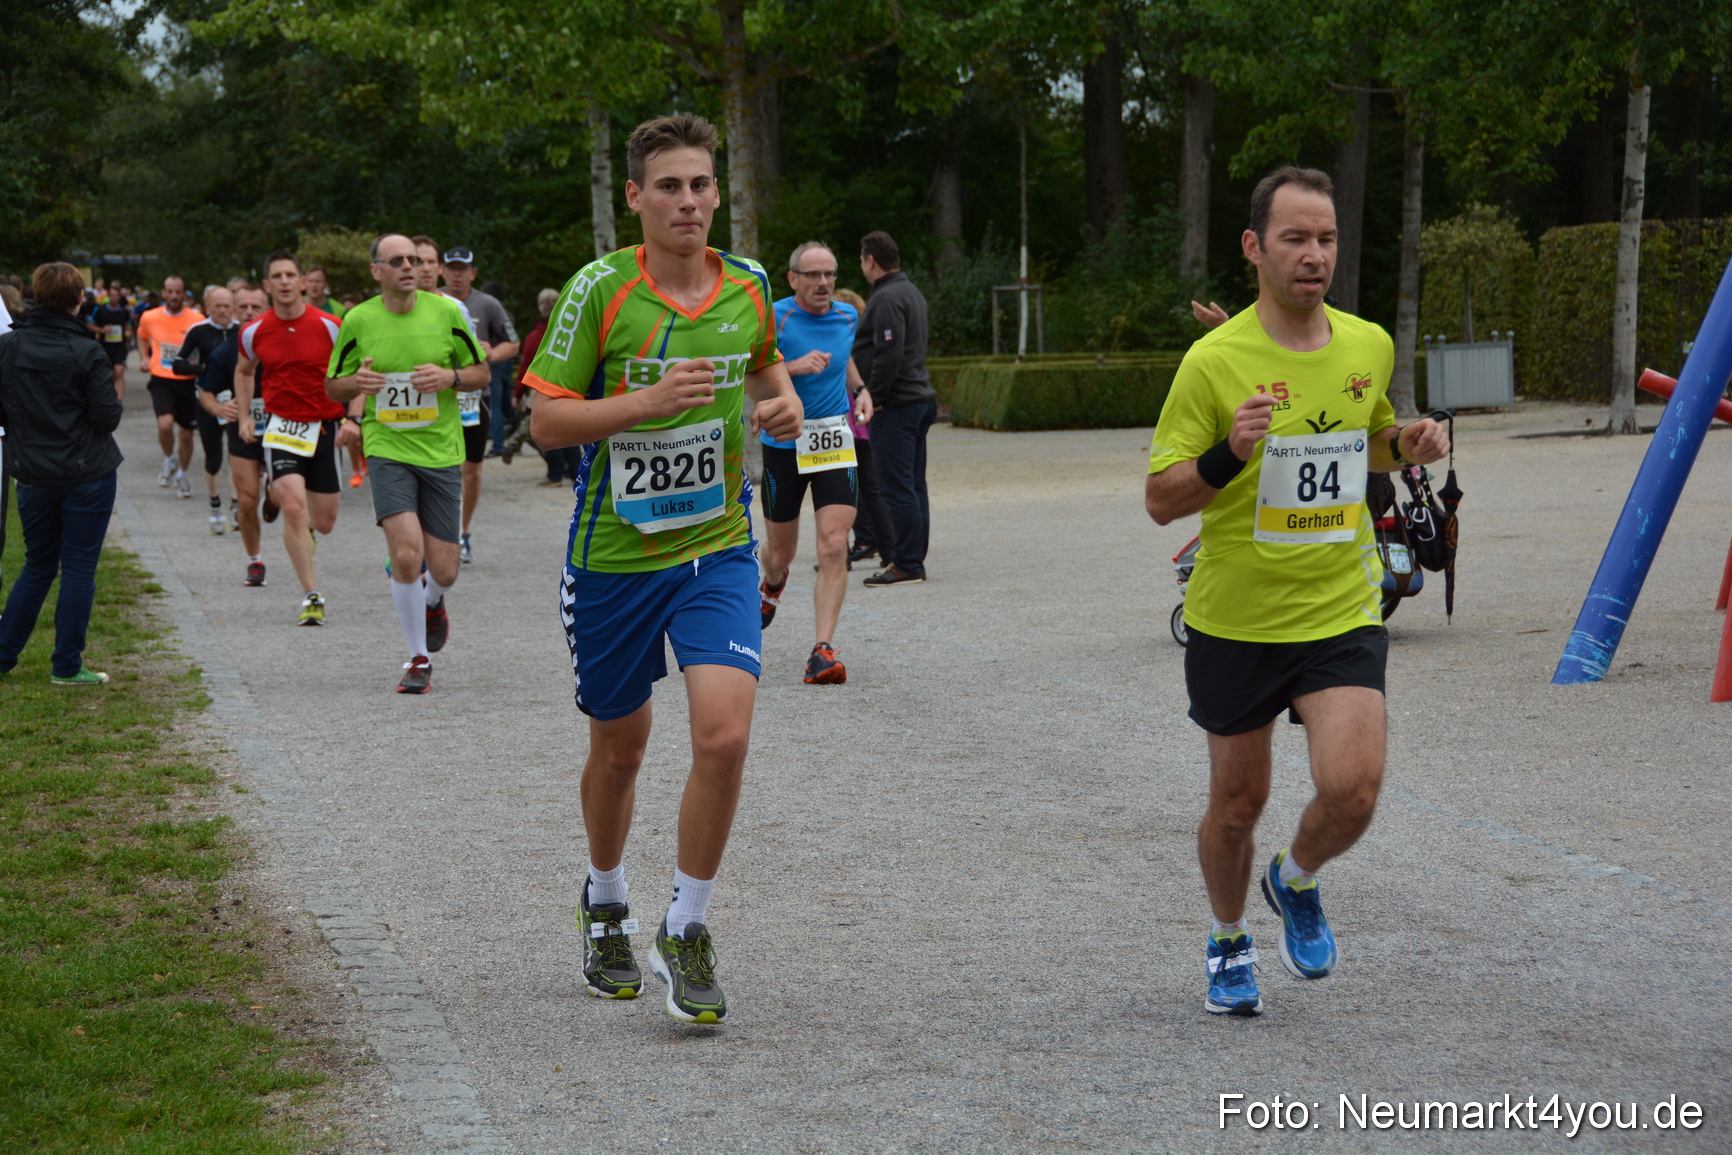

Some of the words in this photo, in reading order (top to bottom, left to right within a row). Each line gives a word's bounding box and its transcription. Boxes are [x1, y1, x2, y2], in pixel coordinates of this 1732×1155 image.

[547, 260, 617, 361] BOCK
[278, 419, 310, 439] 302
[612, 441, 651, 452] PARTL
[652, 433, 707, 450] Neumarkt
[808, 431, 843, 451] 365
[1266, 445, 1302, 457] PARTL
[1304, 443, 1352, 456] Neumarkt
[813, 453, 840, 464] Oswald
[624, 447, 716, 495] 2826
[1297, 461, 1340, 503] 84
[617, 492, 623, 500] A
[651, 499, 695, 517] Lukas
[1287, 511, 1344, 529] Gerhard
